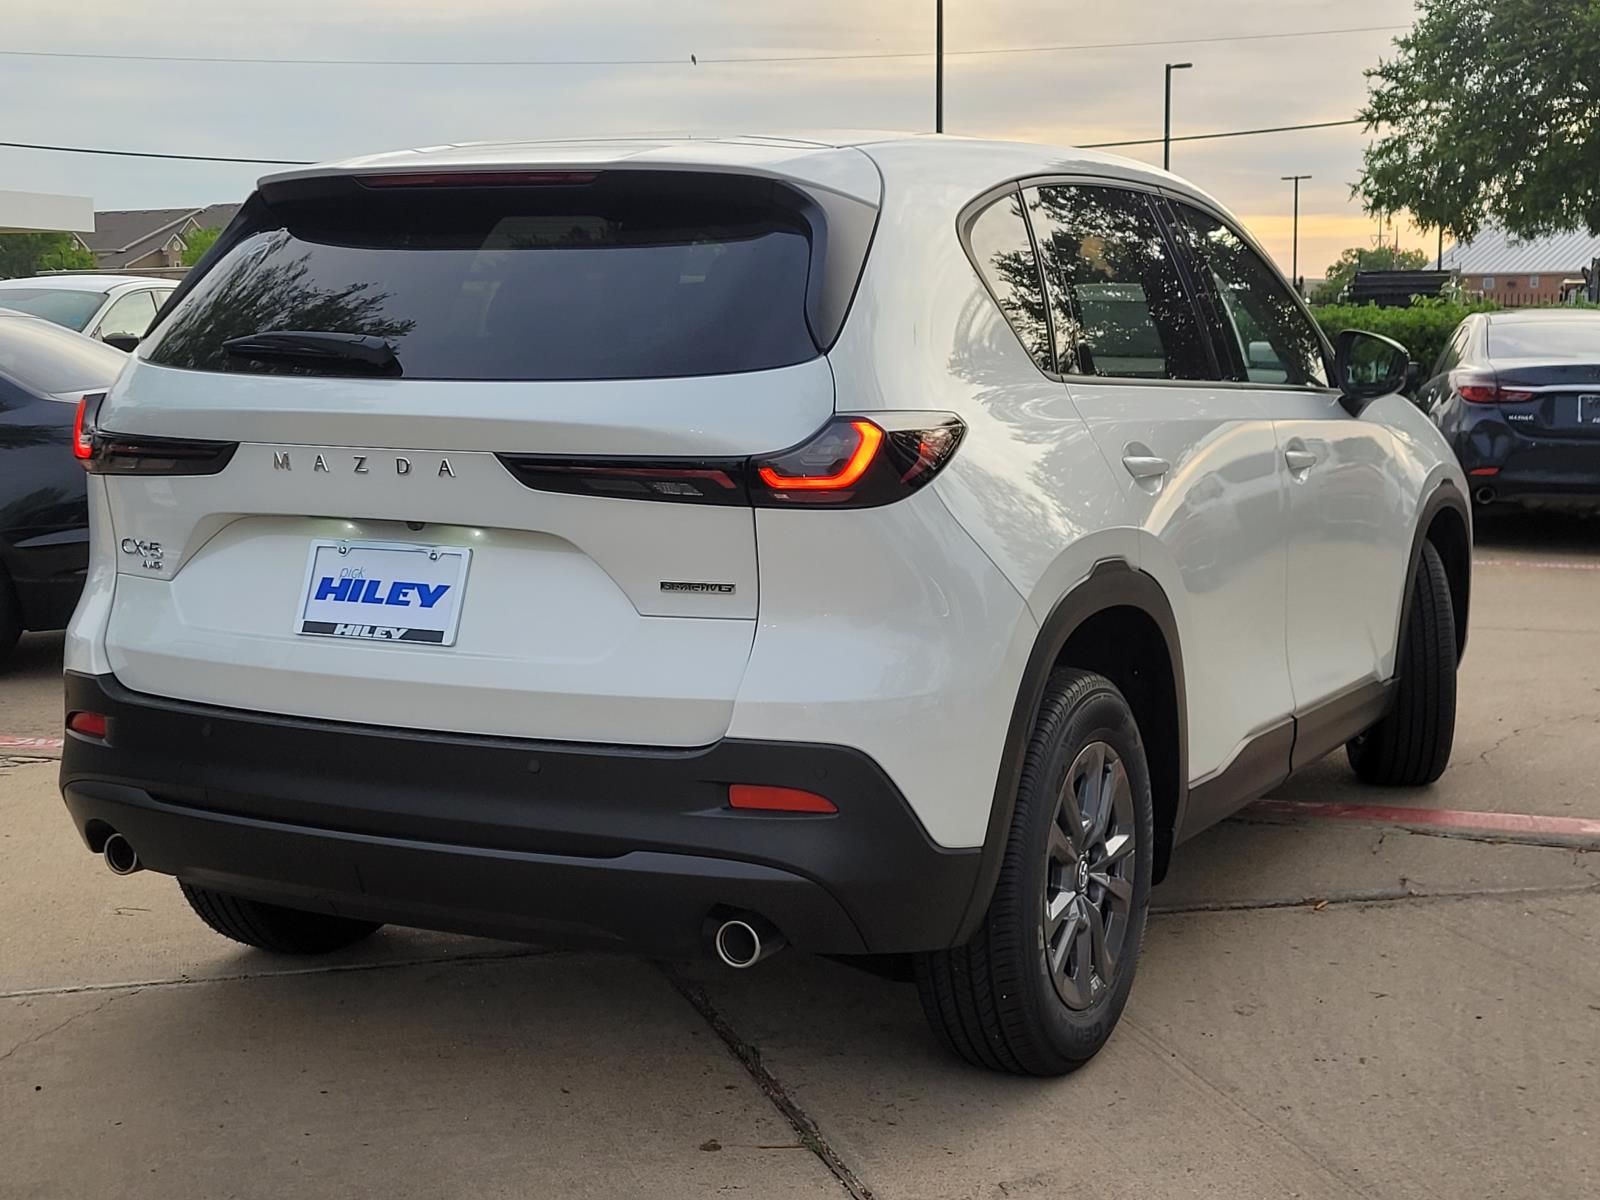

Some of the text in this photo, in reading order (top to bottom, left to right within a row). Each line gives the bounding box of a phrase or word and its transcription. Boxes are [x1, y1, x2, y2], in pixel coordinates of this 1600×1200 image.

[273, 451, 457, 478] MAZDA
[121, 538, 164, 560] CX-5
[314, 576, 451, 609] HILEY
[333, 623, 409, 640] HILEY
